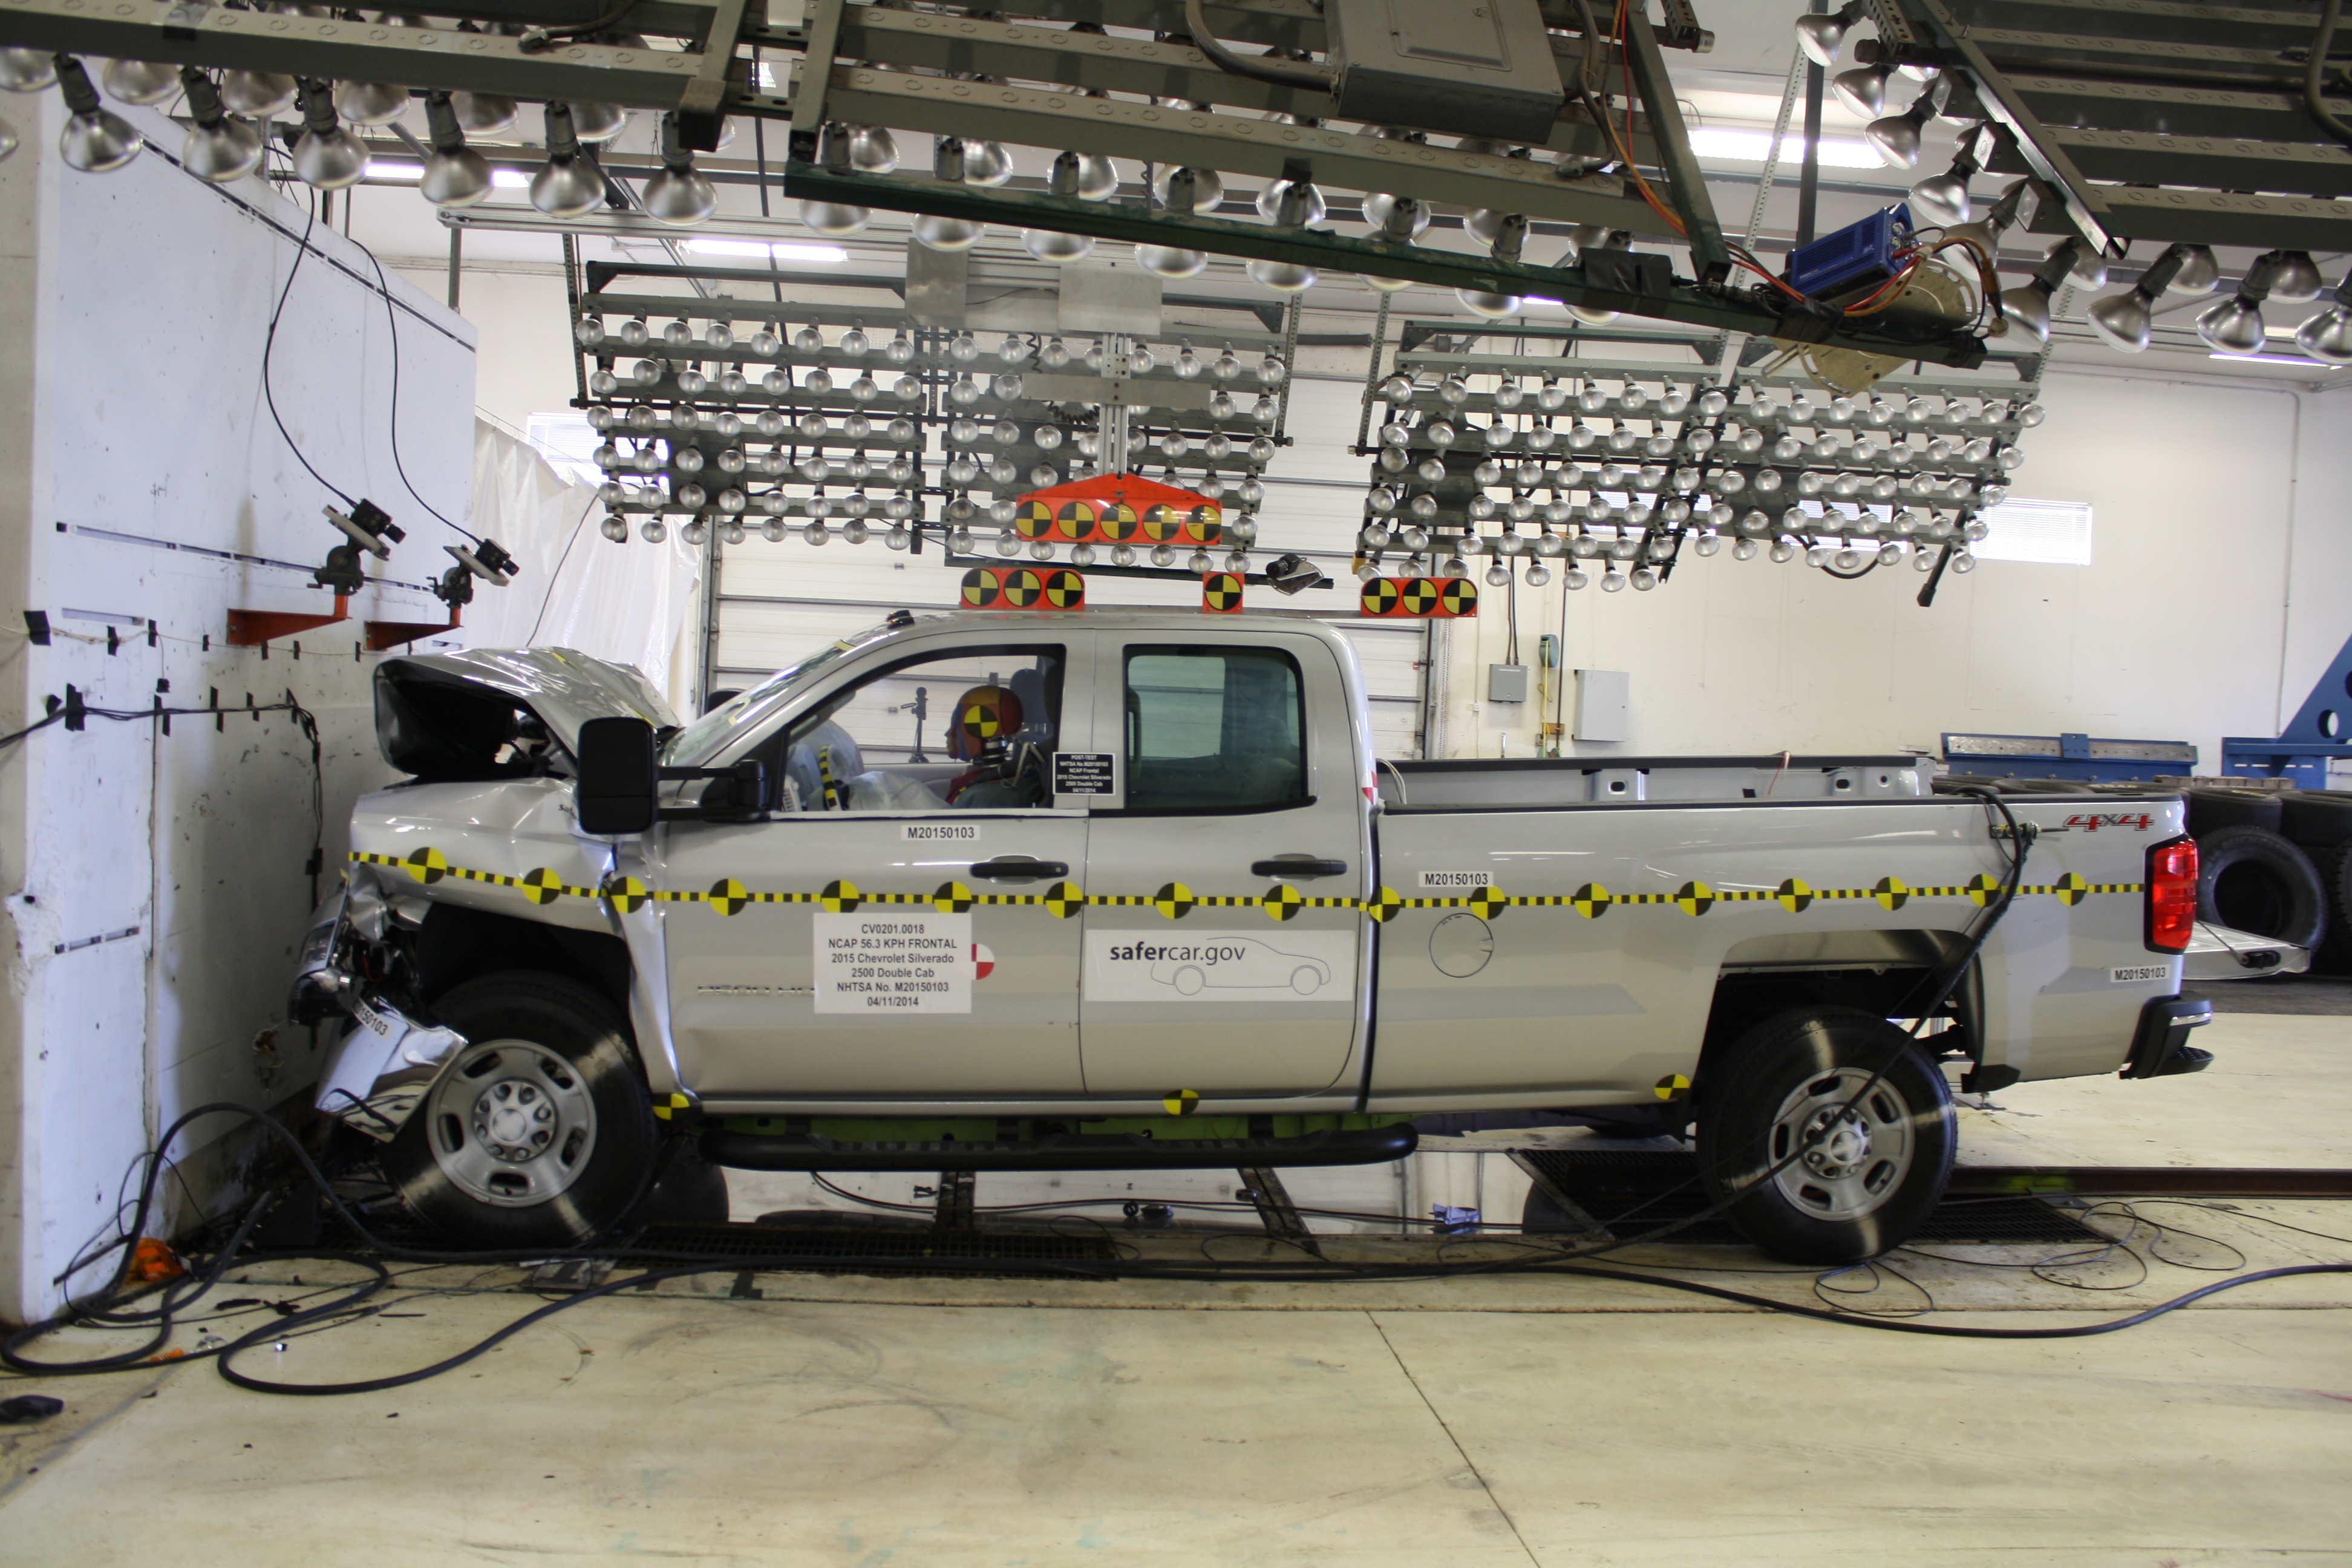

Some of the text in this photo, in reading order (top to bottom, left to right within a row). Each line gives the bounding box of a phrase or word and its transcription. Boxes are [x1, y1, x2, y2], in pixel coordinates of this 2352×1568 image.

[907, 826, 975, 839] M20150103
[1425, 873, 1488, 886] M20150103
[861, 924, 925, 935] CV0201.0018
[828, 938, 957, 949] NCAP 56.3 KPH FRONTAL
[831, 953, 955, 964] 2015 Chevrolet Silverado
[1109, 941, 1246, 966] safercar.gov
[851, 967, 935, 978] 2500 Double Cab
[2114, 967, 2166, 981] M20150103
[837, 982, 949, 992] NHTSA No. M20150103
[867, 996, 920, 1007] 04/11/2014
